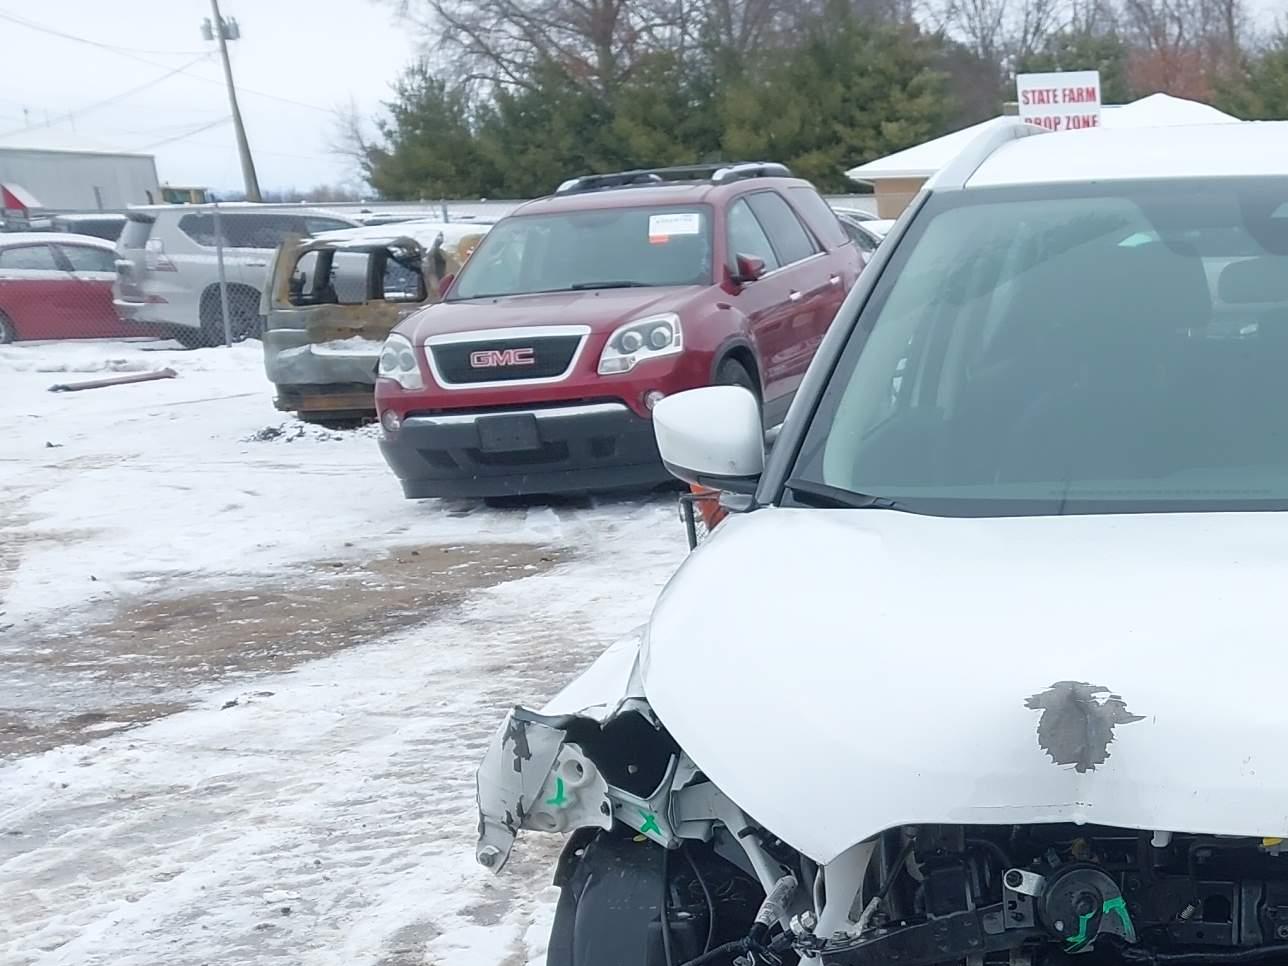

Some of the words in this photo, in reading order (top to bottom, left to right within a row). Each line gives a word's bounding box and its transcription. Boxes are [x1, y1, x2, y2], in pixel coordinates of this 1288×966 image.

[1021, 89, 1058, 105] STATE
[1062, 87, 1097, 103] FARM
[470, 347, 535, 368] GMC
